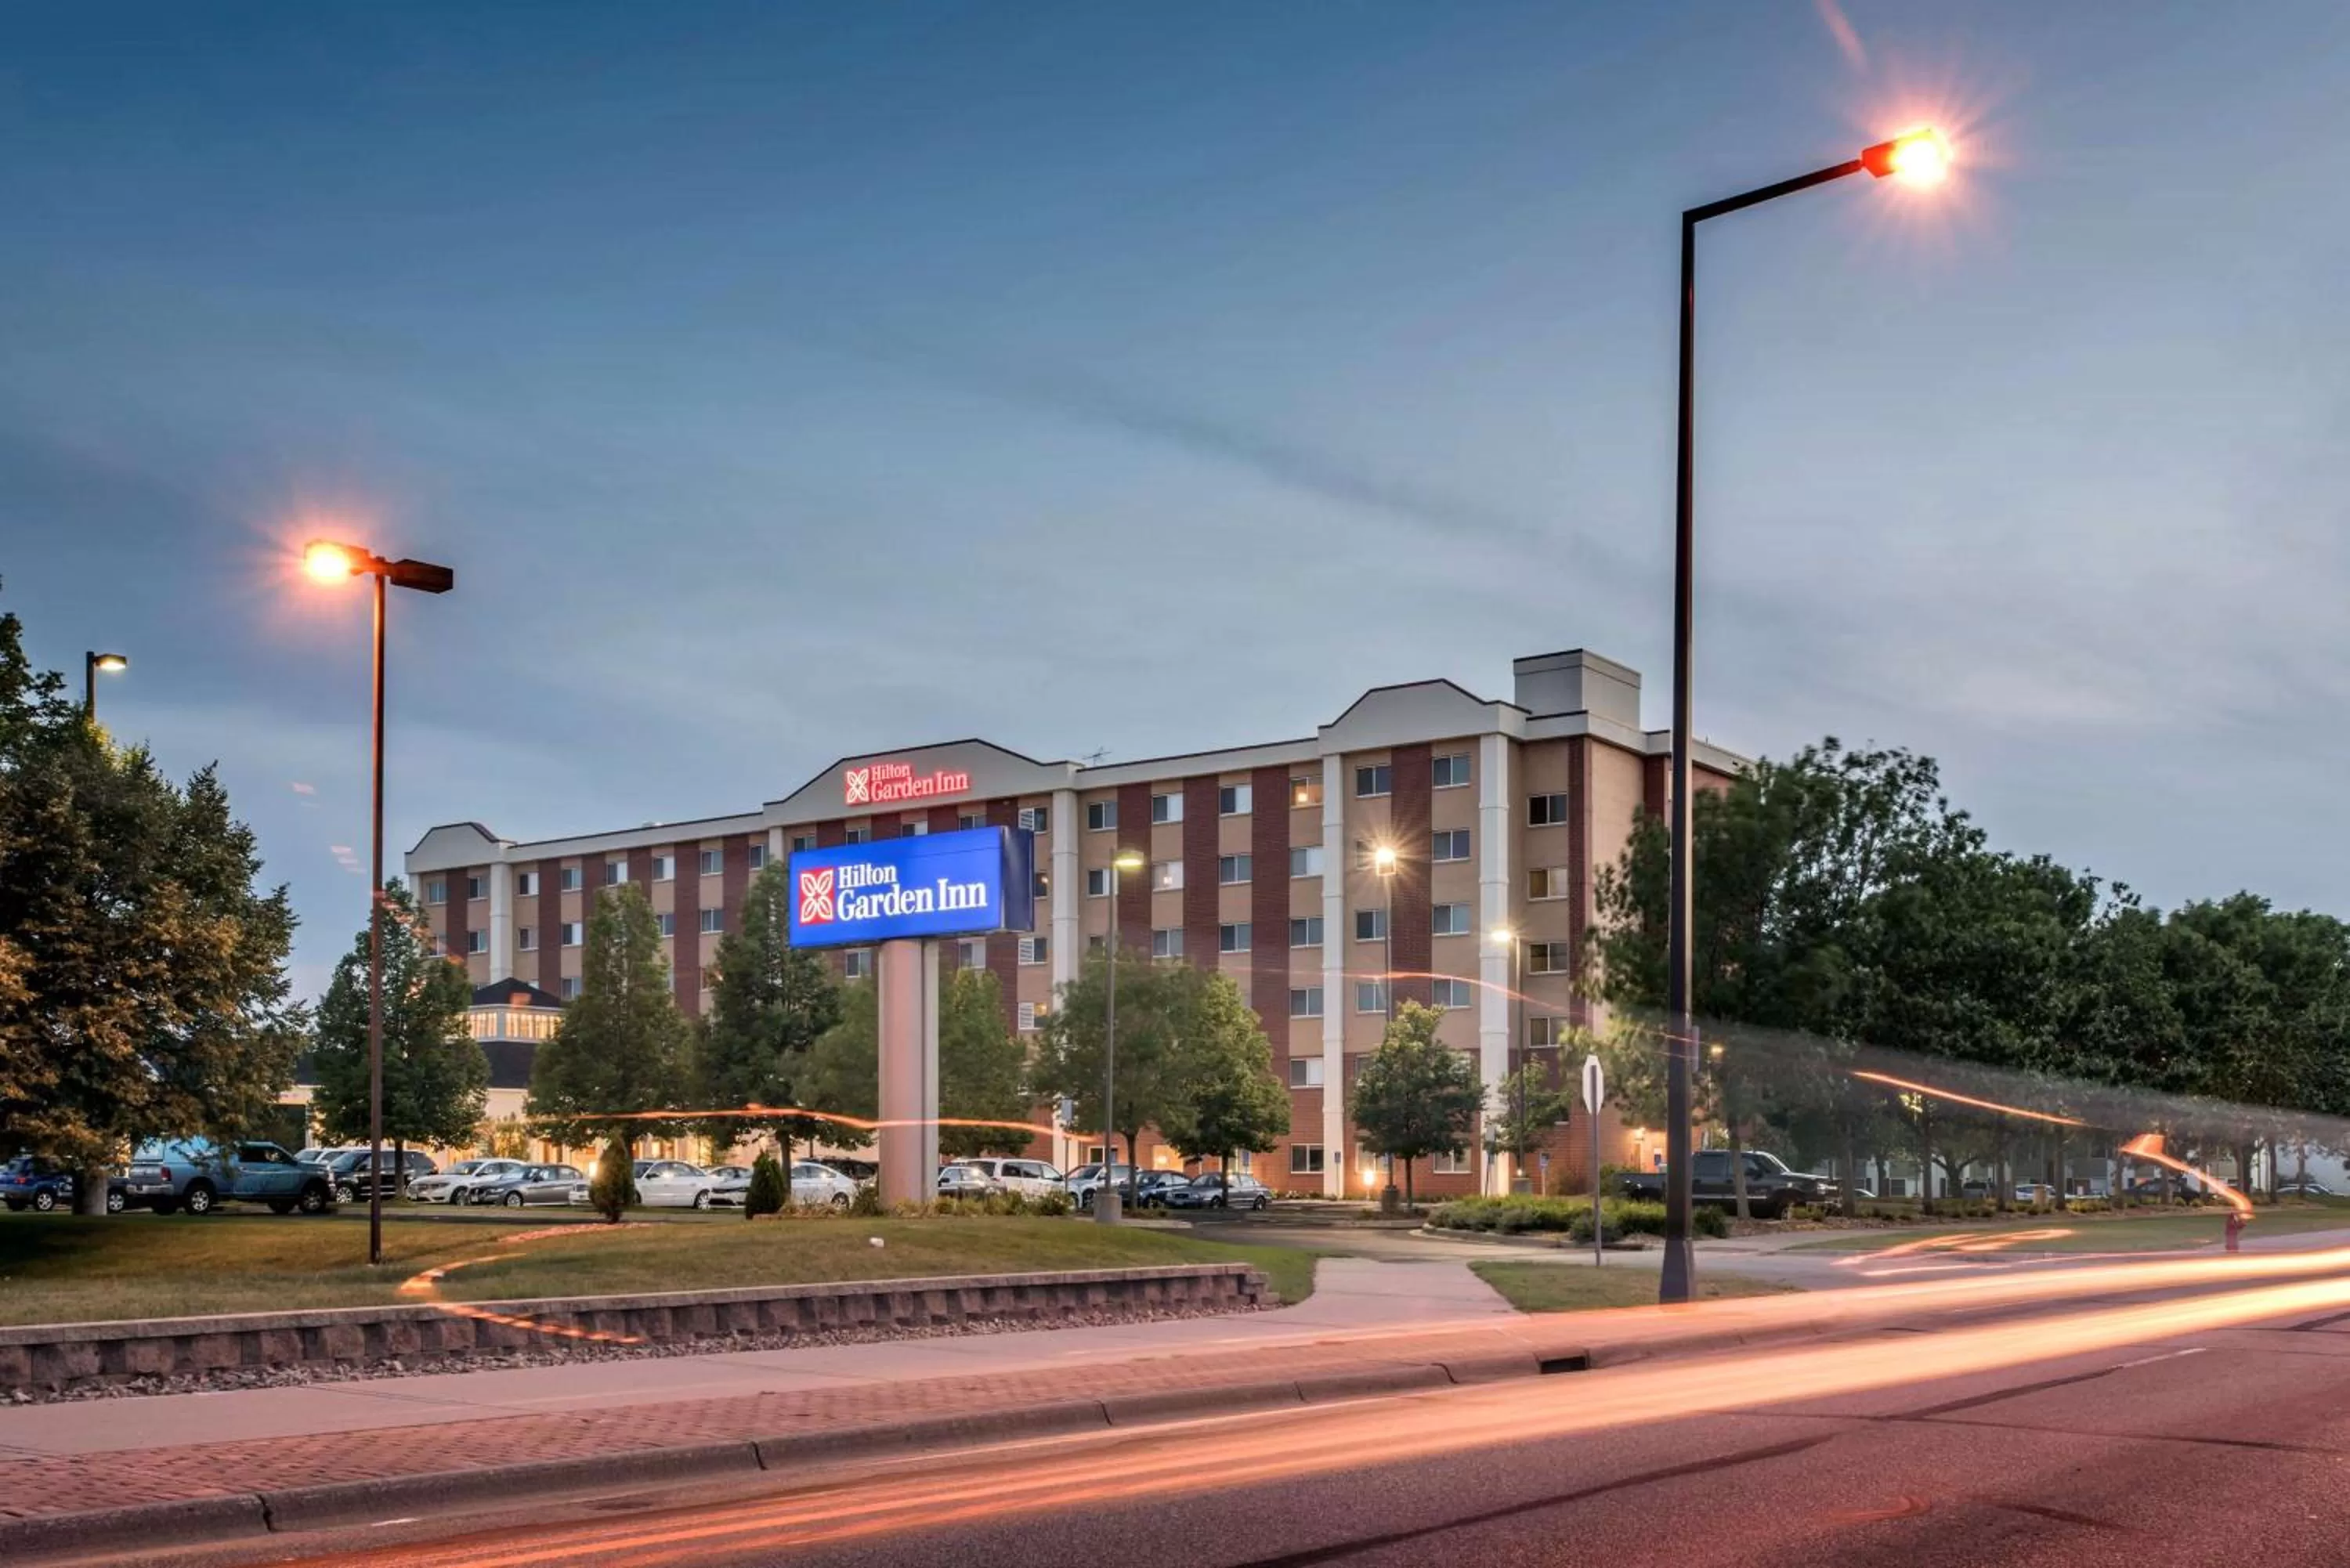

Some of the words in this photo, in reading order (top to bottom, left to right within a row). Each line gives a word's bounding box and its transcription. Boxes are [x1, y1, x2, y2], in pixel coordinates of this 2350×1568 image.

[871, 777, 934, 801] Garden
[935, 771, 968, 793] Inn
[872, 764, 910, 781] Hilton
[838, 863, 896, 888] Hilton
[837, 883, 934, 921] Garden
[937, 878, 988, 910] Inn
